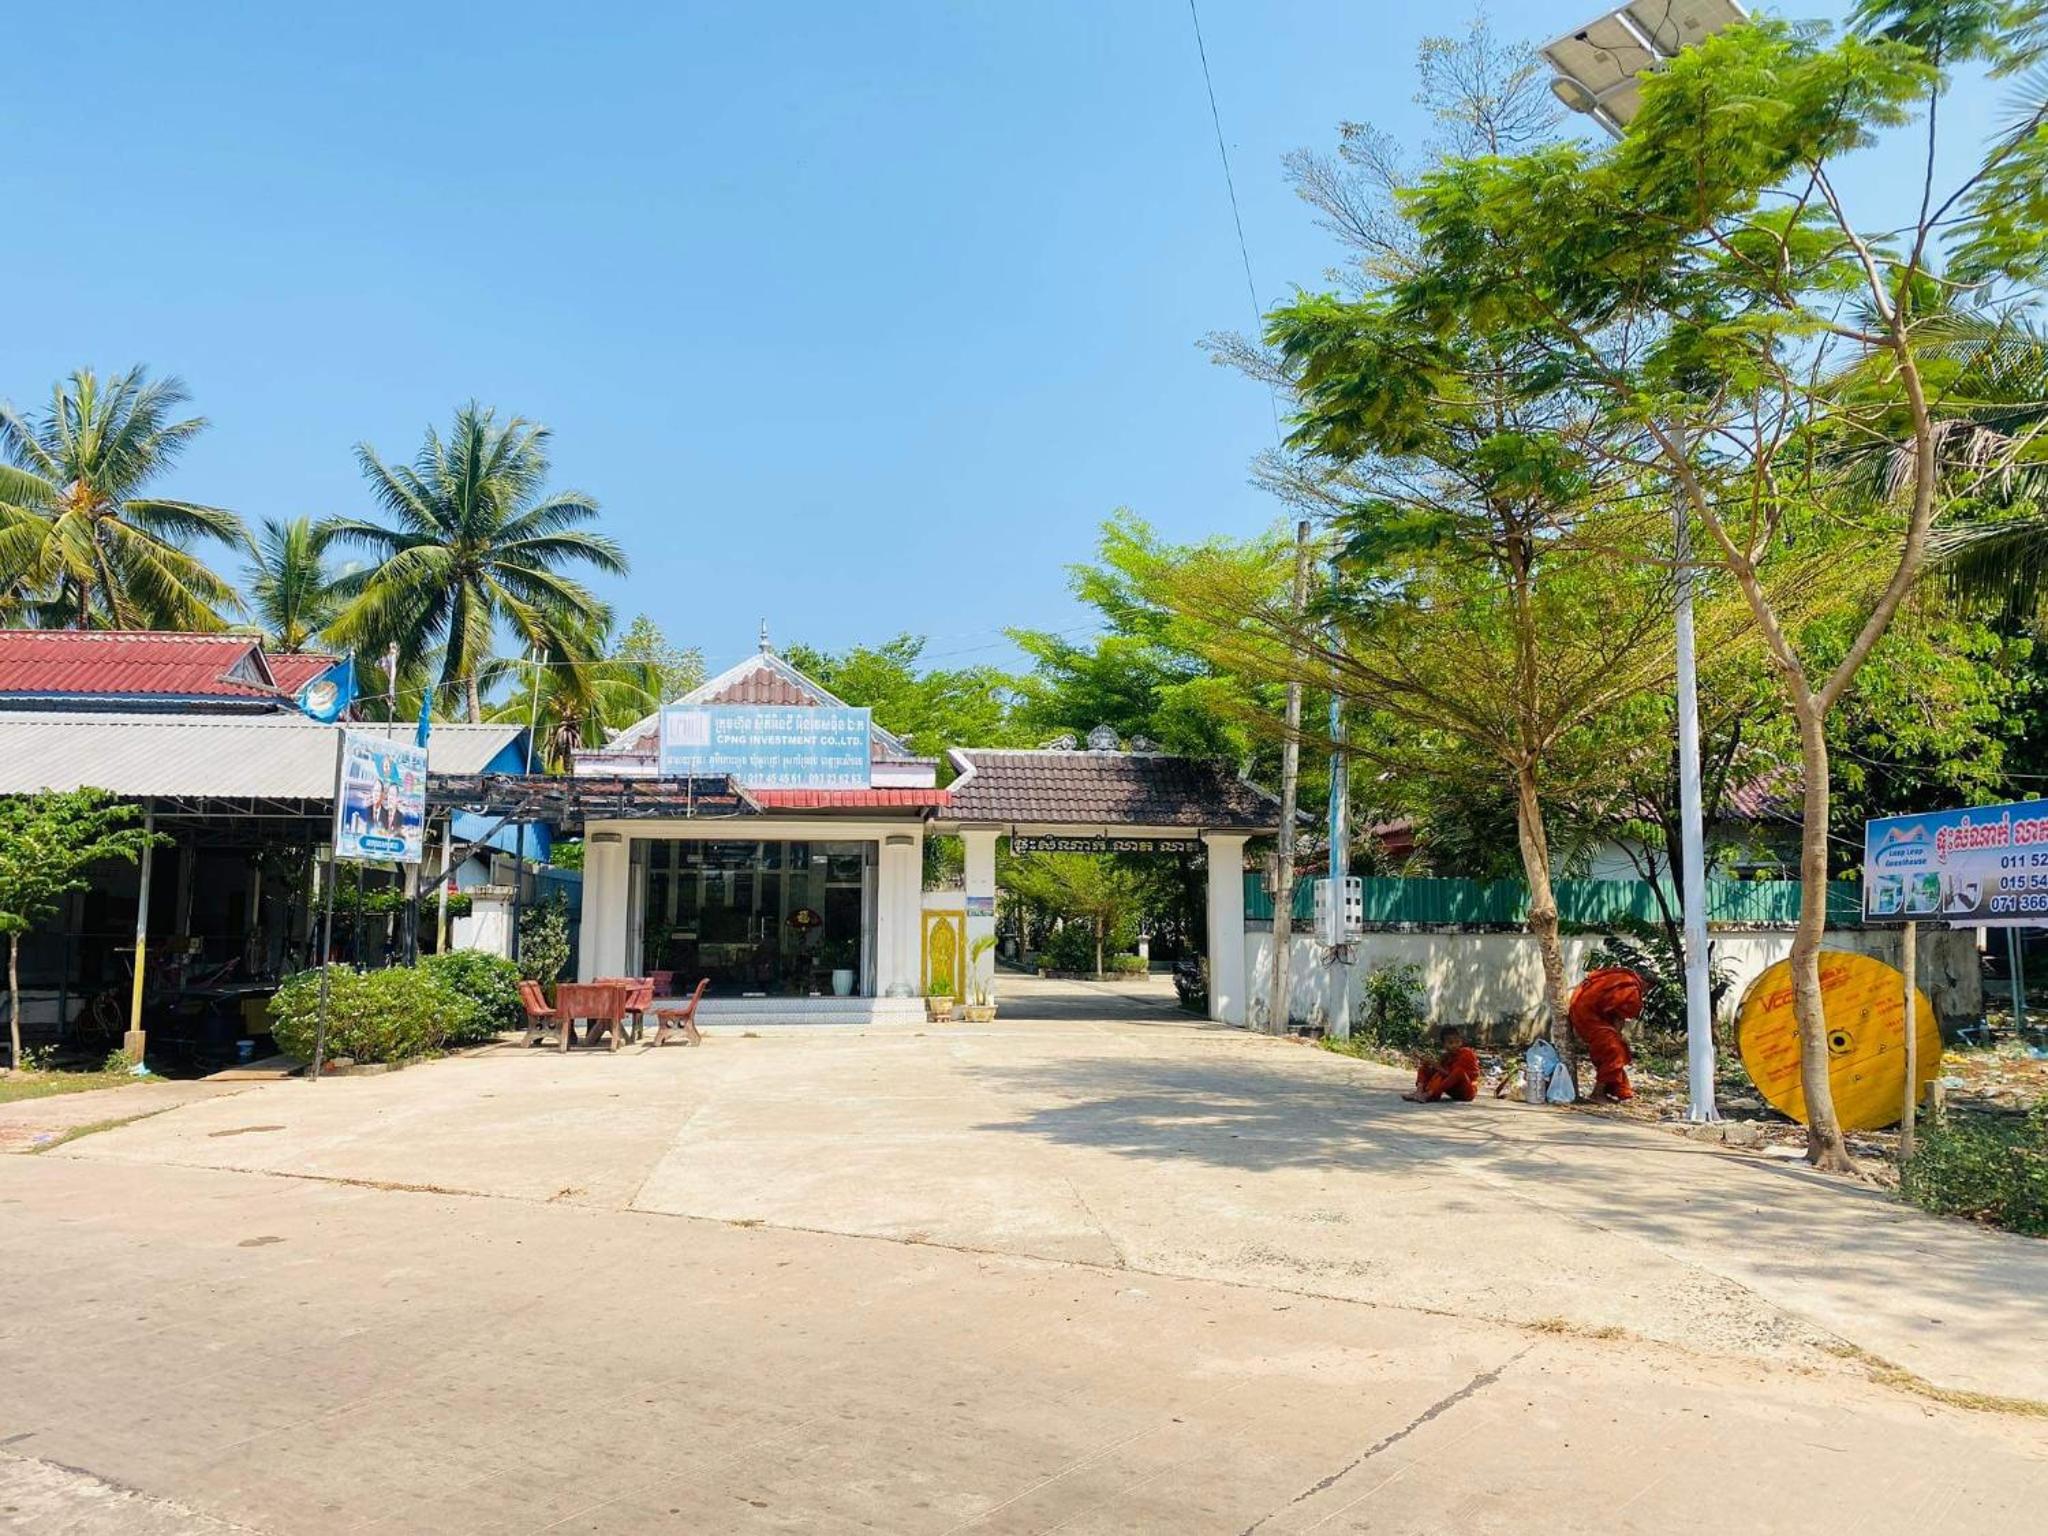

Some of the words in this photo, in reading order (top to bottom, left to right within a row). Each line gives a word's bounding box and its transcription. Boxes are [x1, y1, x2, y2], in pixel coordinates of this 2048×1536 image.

[716, 735, 747, 744] CPNG
[750, 736, 817, 745] INVESTMENT
[2001, 855, 2025, 868] 011
[2031, 853, 2048, 866] 52
[2000, 876, 2025, 889] 015
[2030, 874, 2048, 887] 54
[1991, 897, 2015, 910] 071
[2021, 895, 2048, 909] 366
